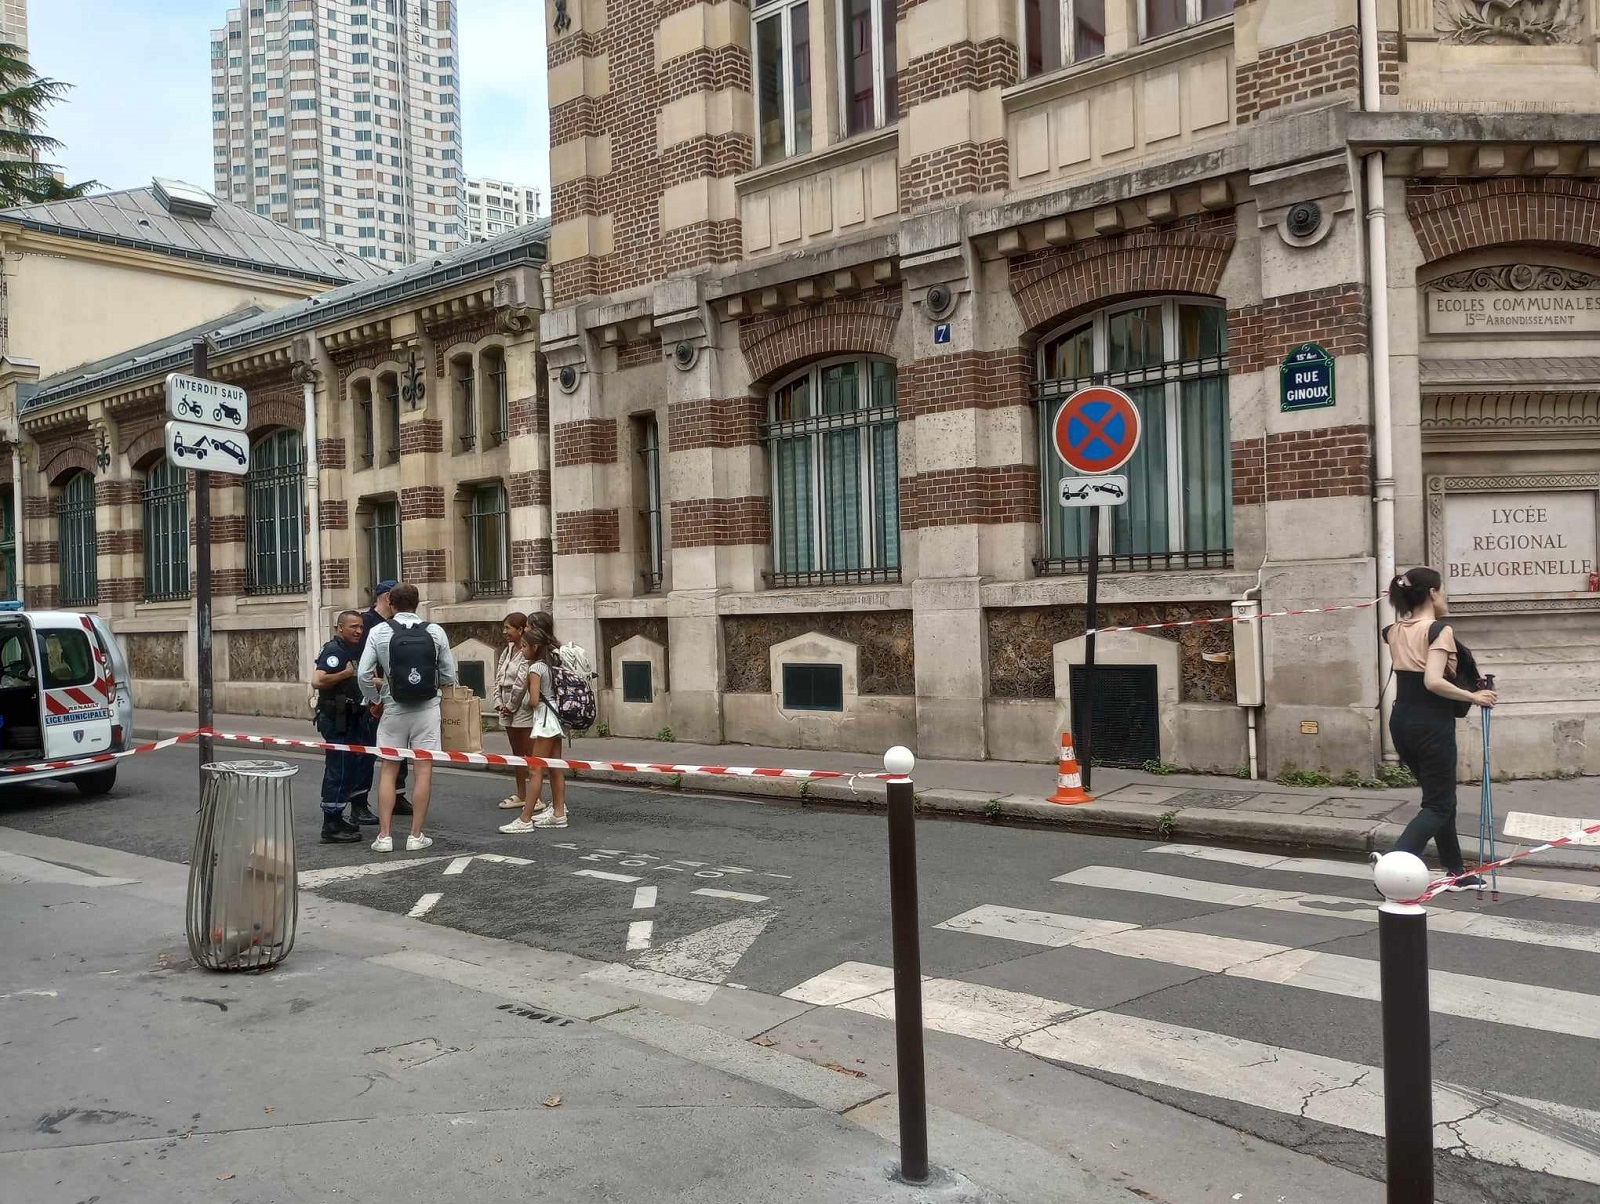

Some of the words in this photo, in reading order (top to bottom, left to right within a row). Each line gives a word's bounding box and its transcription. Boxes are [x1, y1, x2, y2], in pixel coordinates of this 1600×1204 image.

[1437, 298, 1485, 312] ECOLES
[937, 325, 947, 342] 7
[1295, 371, 1319, 384] RUE
[175, 378, 218, 396] INTERDIT
[221, 388, 244, 401] SAUF
[1287, 386, 1329, 401] GINOUX
[1492, 505, 1548, 524] LYCÉE
[1473, 533, 1567, 551] RÉGIONAL
[1449, 560, 1592, 578] BEAUGRENELLE
[69, 702, 100, 711] RENAULT
[63, 711, 107, 722] MUNICIPALE
